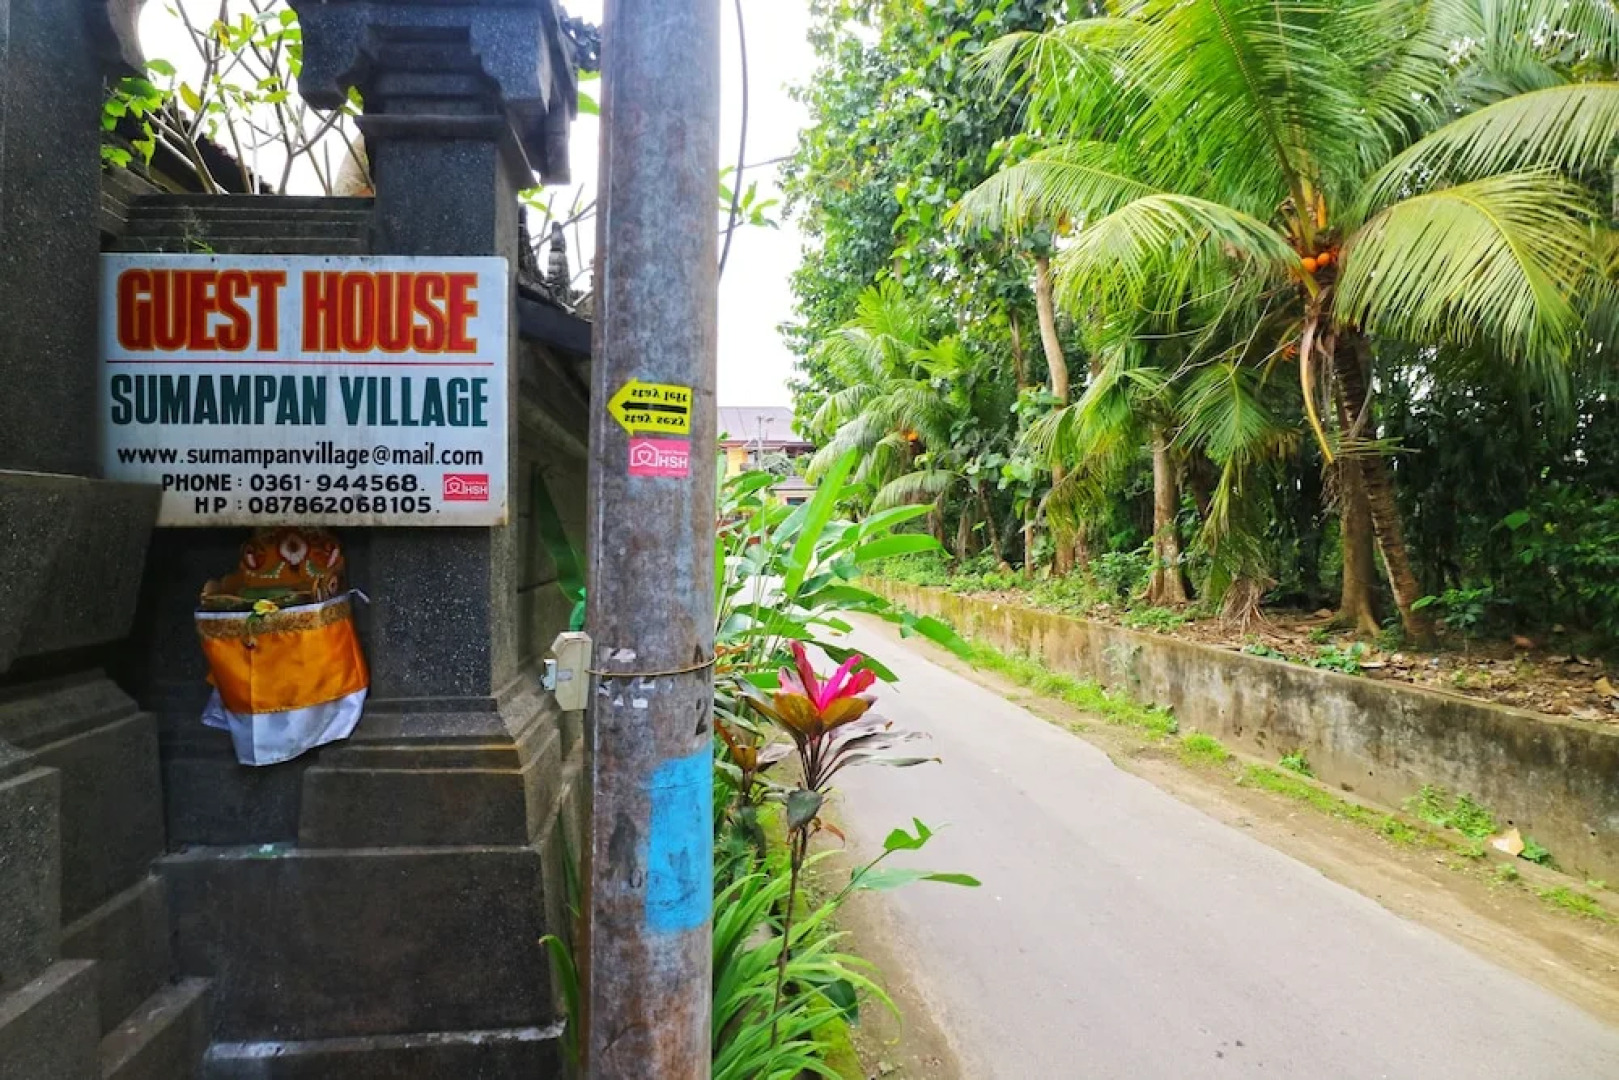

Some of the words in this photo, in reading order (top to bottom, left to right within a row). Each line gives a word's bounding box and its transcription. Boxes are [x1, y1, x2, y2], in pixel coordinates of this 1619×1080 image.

[117, 268, 287, 352] GUEST
[301, 271, 479, 354] HOUSE
[111, 373, 327, 426] SUMAMPAN
[339, 376, 489, 427] VILLAGE
[117, 440, 484, 469] www.sumampanvillage@mail.com
[658, 455, 688, 469] HSH
[464, 484, 488, 495] HSH
